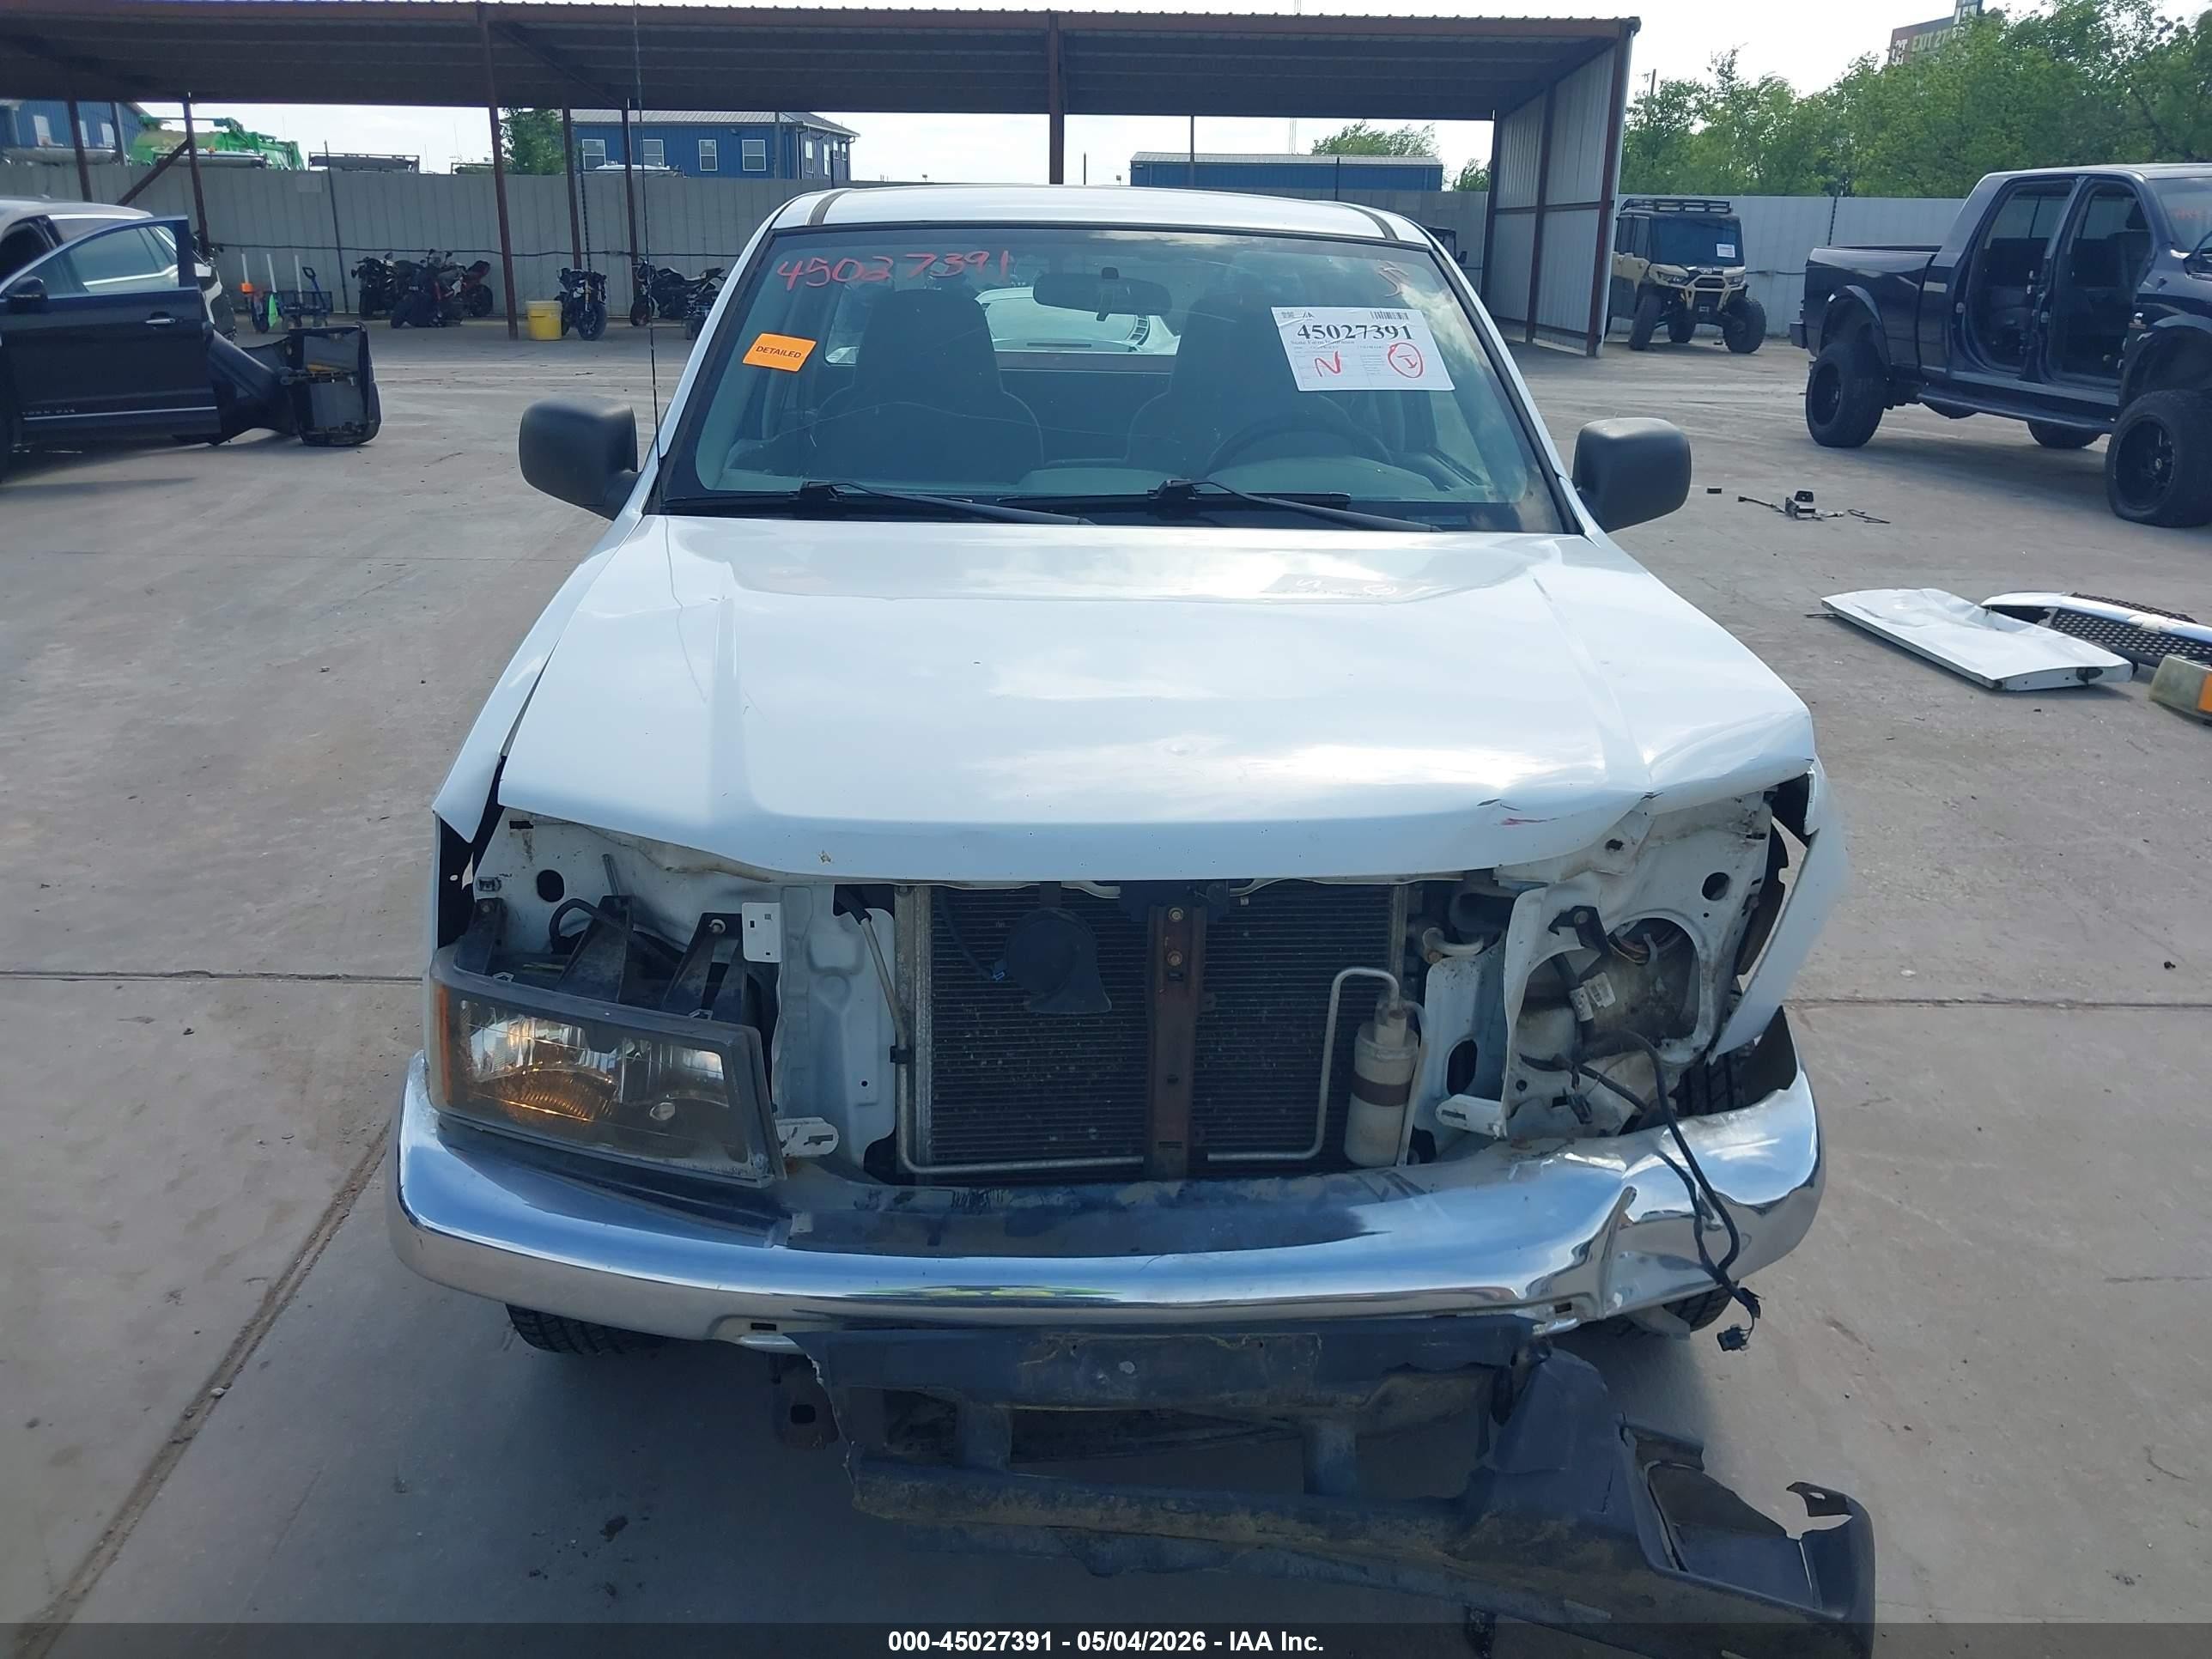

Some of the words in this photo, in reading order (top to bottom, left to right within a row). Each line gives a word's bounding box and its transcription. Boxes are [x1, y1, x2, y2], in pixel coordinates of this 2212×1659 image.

[1911, 31, 1935, 52] EXIT
[777, 250, 1010, 291] 45027391
[1297, 324, 1415, 340] 45027391
[756, 345, 802, 359] DETAILED
